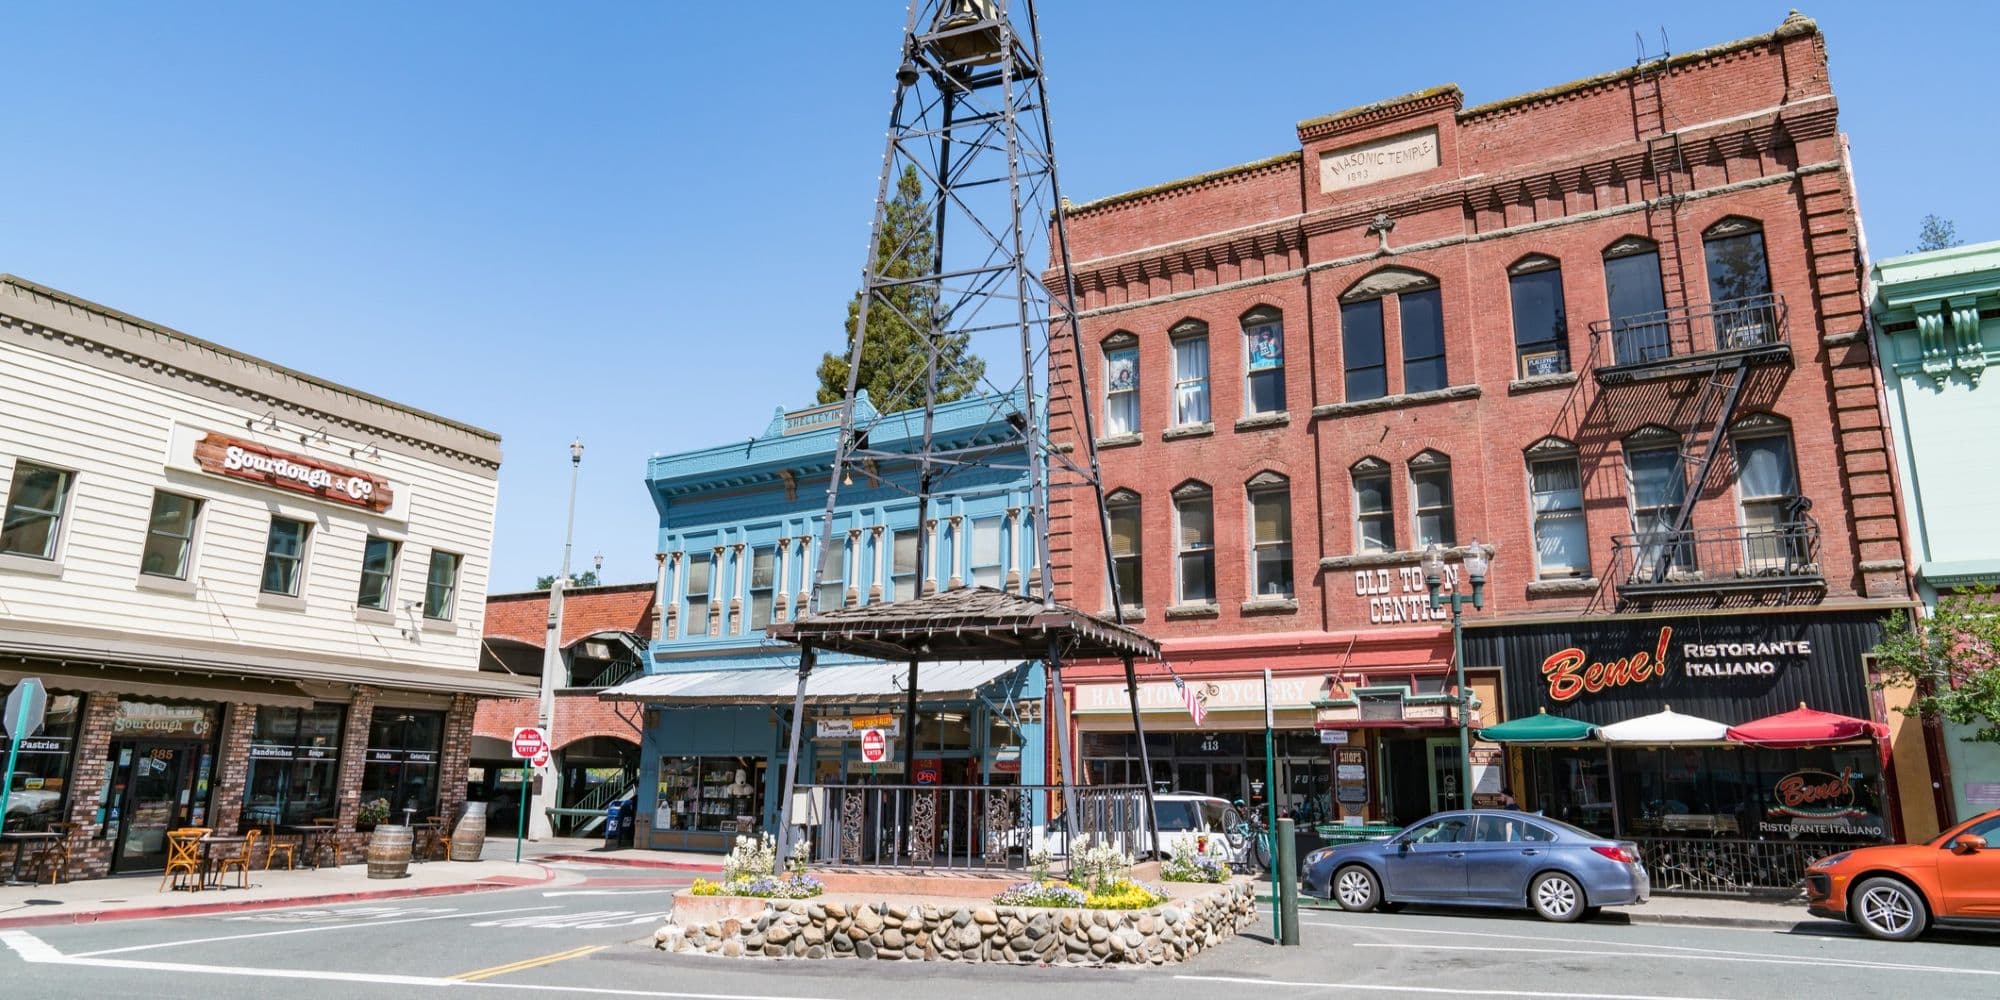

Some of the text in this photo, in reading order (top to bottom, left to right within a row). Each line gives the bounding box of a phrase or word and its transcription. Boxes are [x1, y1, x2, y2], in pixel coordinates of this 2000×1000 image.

[1331, 152, 1385, 175] MASONIC
[787, 411, 830, 429] SHELLEY
[224, 446, 333, 488] Sourdough
[335, 479, 346, 491] &
[1355, 563, 1459, 595] OLD TON
[1541, 626, 1812, 700] Bene! RISTORANTE
[1686, 661, 1775, 677] ITALIANO
[114, 717, 183, 732] Sourdough
[20, 740, 60, 750] Pastries
[252, 748, 293, 757] Sandwiches
[1201, 741, 1220, 751] 413
[151, 749, 173, 760] 385
[1340, 752, 1362, 763] SHOPS
[917, 772, 936, 782] OPEN
[1780, 766, 1852, 806] Bene!
[1760, 821, 1882, 835] RISTORANTE ITALIANO
